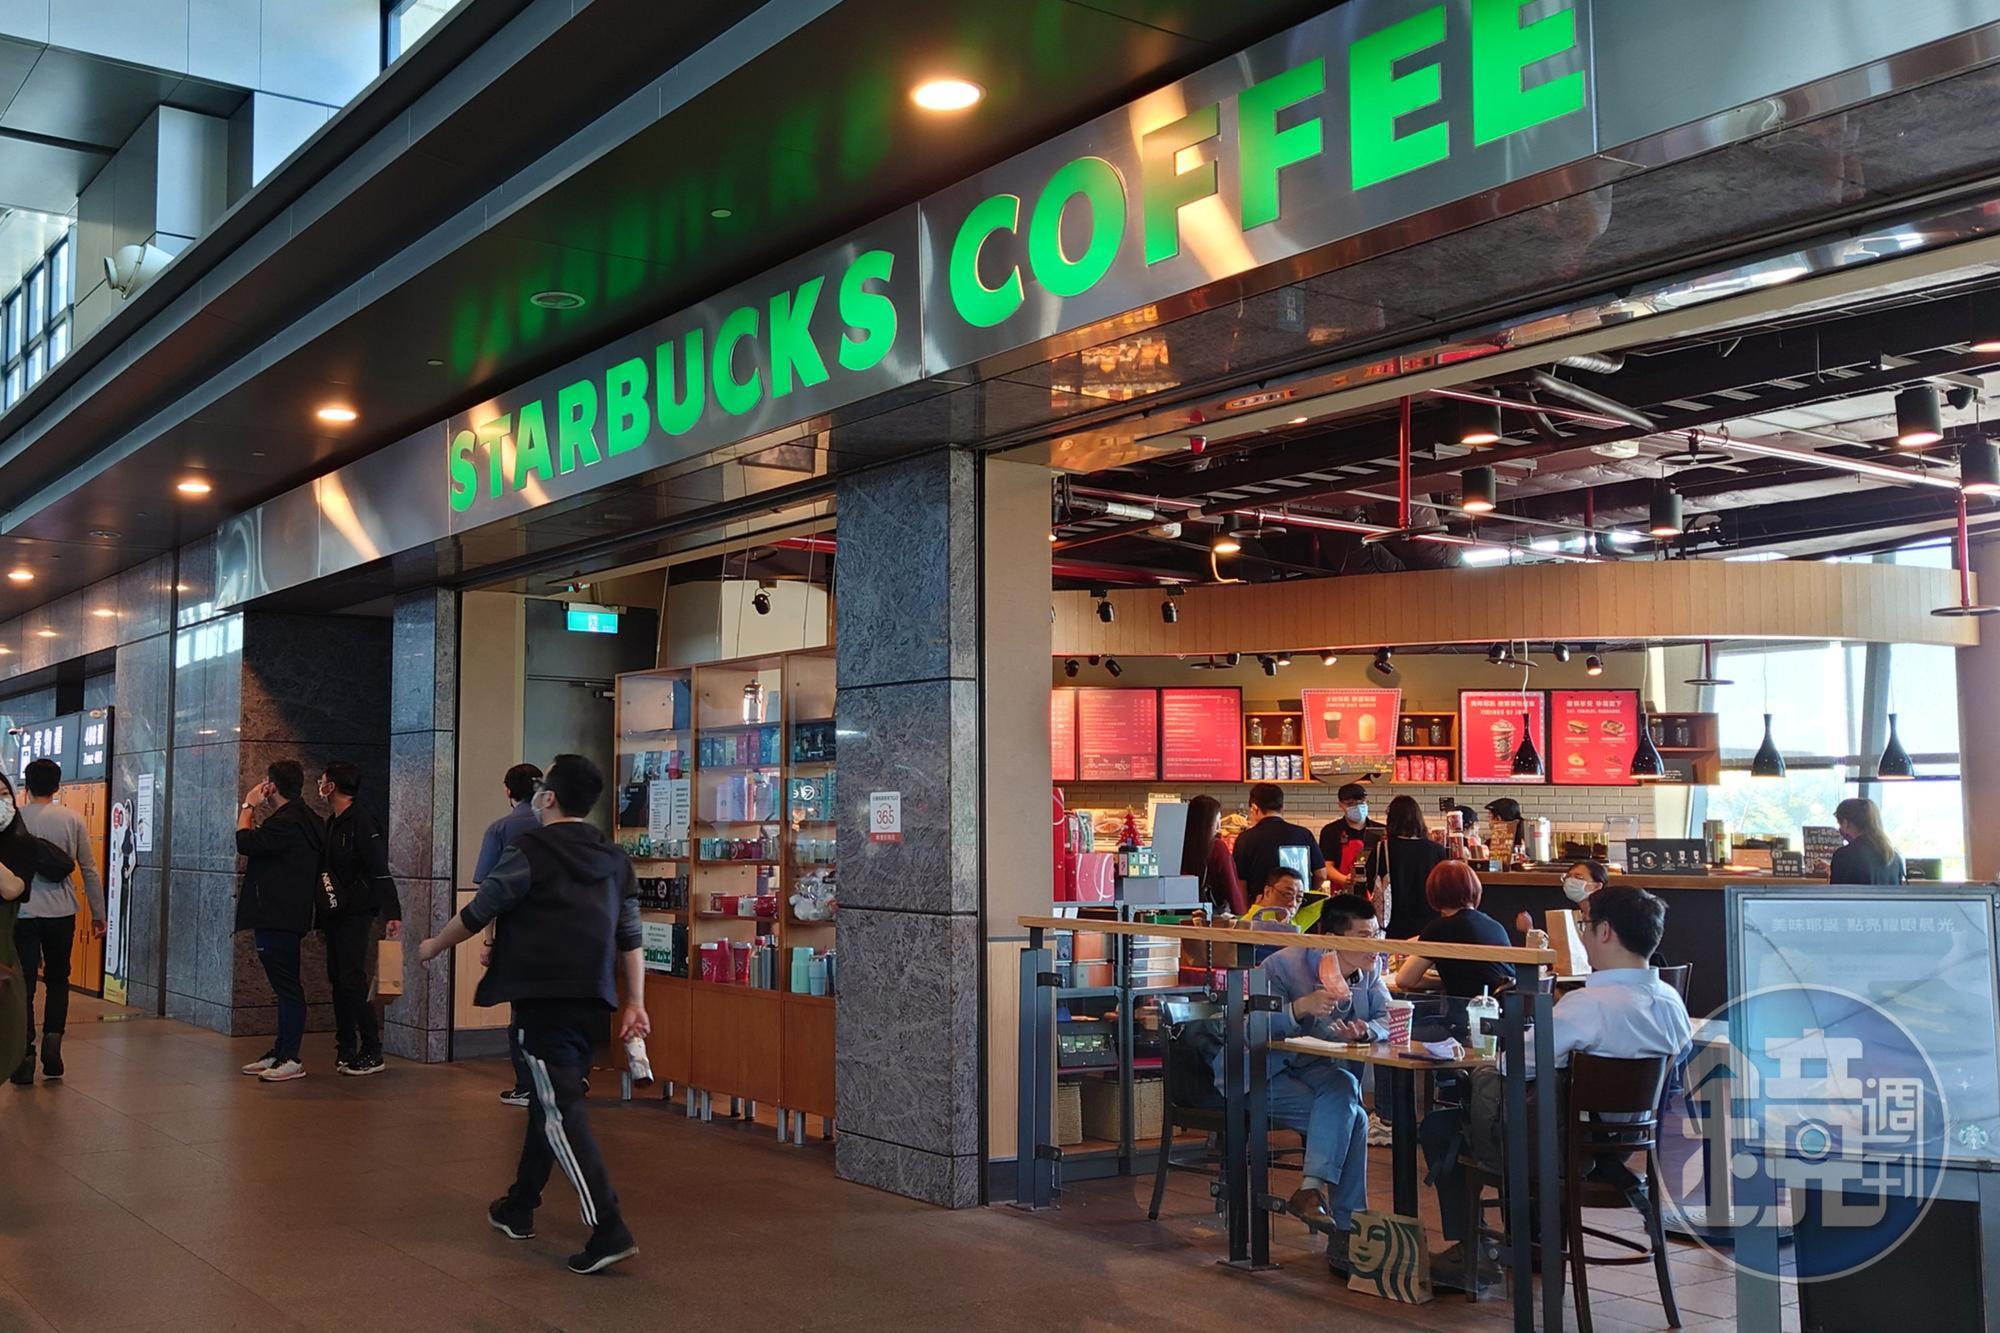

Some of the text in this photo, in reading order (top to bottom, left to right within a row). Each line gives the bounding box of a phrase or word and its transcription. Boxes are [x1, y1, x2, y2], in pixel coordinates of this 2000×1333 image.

[450, 0, 1586, 513] STARBUCKS COFFEE
[876, 809, 895, 825] 365
[321, 872, 338, 909] NIKE AIR
